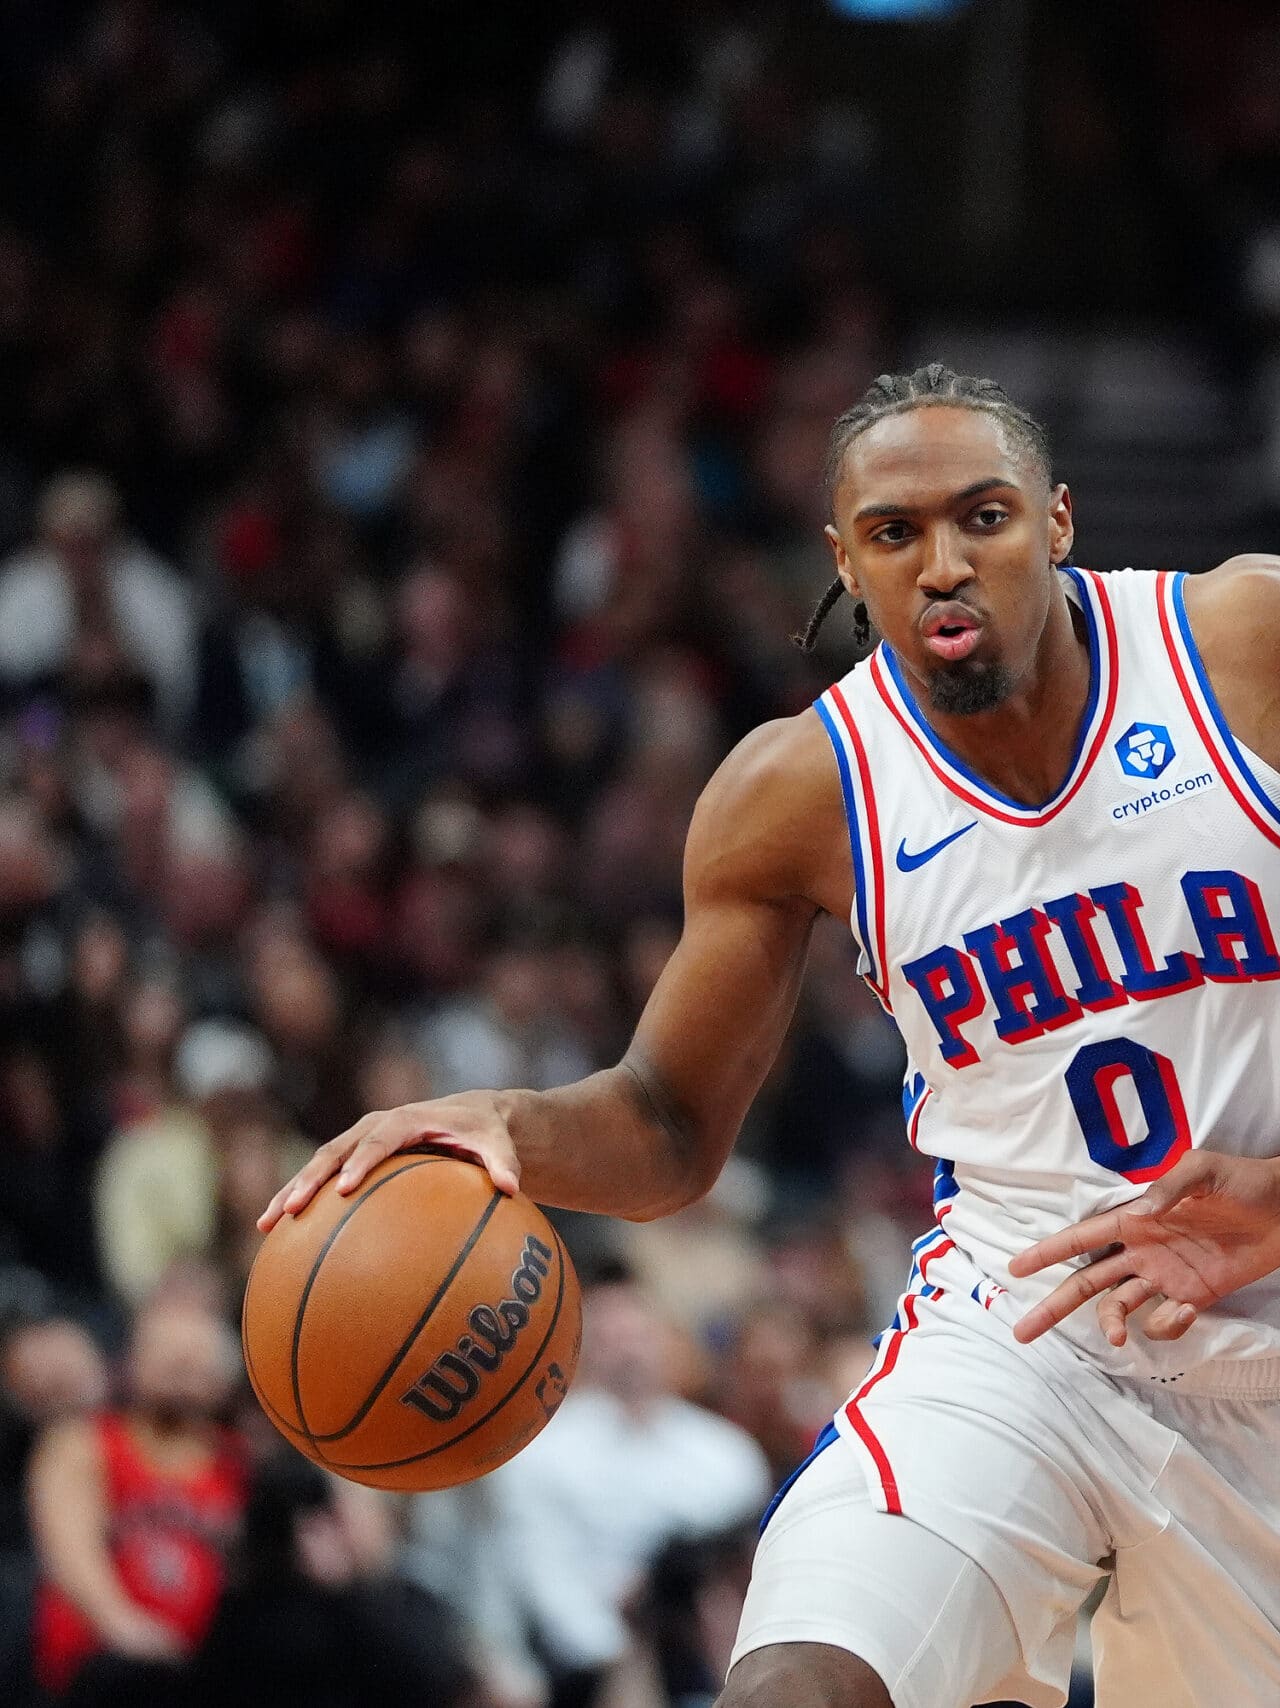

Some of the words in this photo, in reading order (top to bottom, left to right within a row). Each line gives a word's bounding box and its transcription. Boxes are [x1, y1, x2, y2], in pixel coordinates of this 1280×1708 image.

[1112, 773, 1213, 819] crypto.com
[1065, 1037, 1192, 1184] 0
[400, 1234, 551, 1423] Wilson
